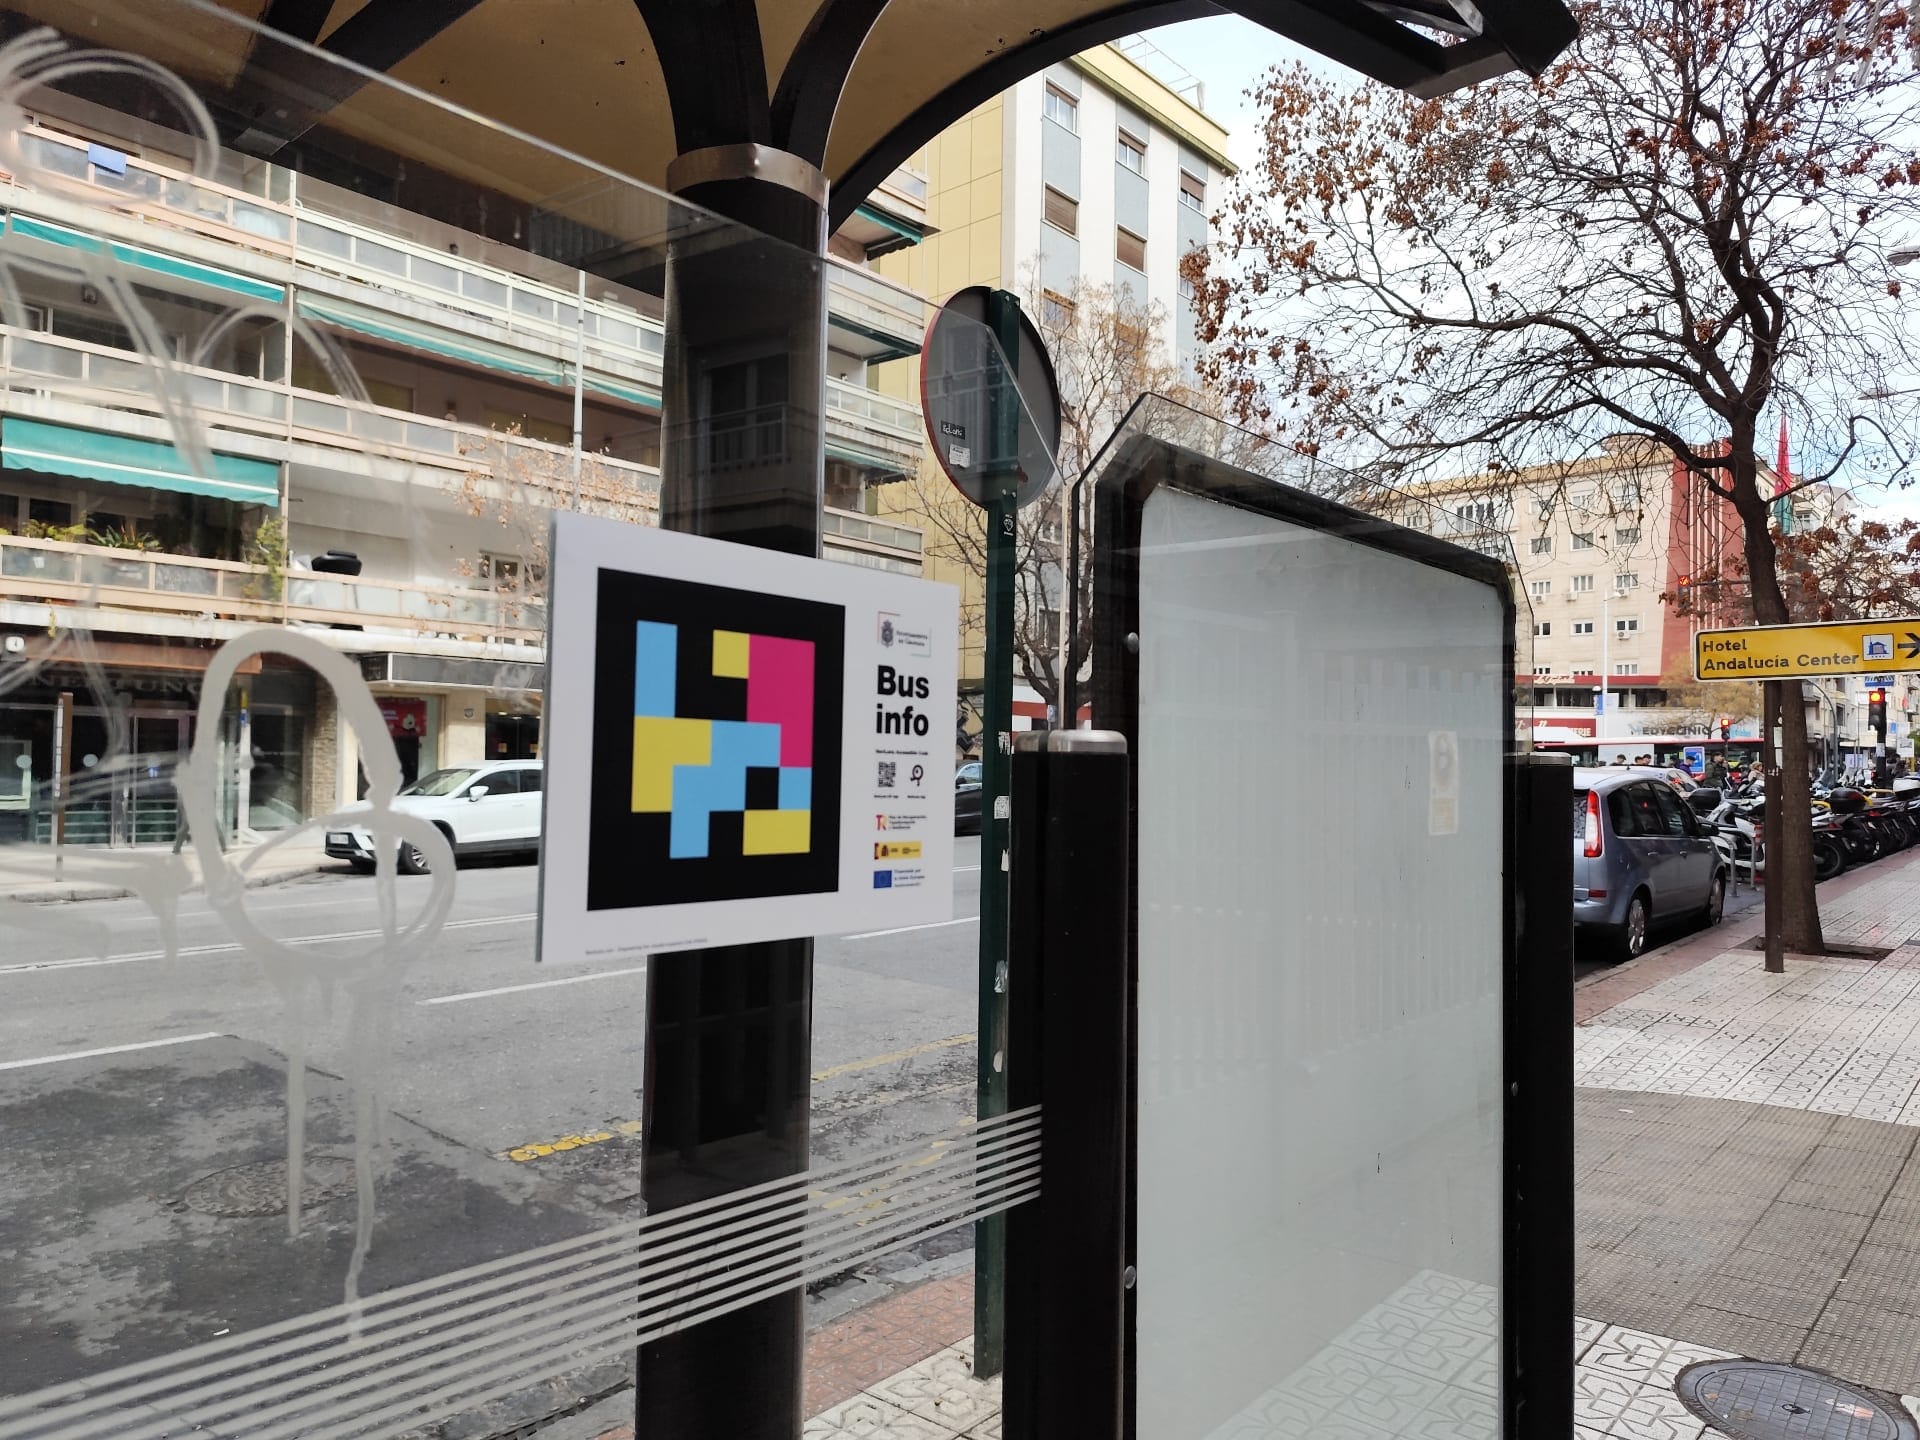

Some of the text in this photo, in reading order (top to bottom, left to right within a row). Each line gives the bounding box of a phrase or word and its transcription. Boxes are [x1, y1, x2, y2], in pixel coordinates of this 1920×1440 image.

[1703, 639, 1747, 652] Hotel
[1704, 653, 1859, 671] Andalucía Center
[877, 664, 930, 699] Bus
[876, 703, 929, 736] info
